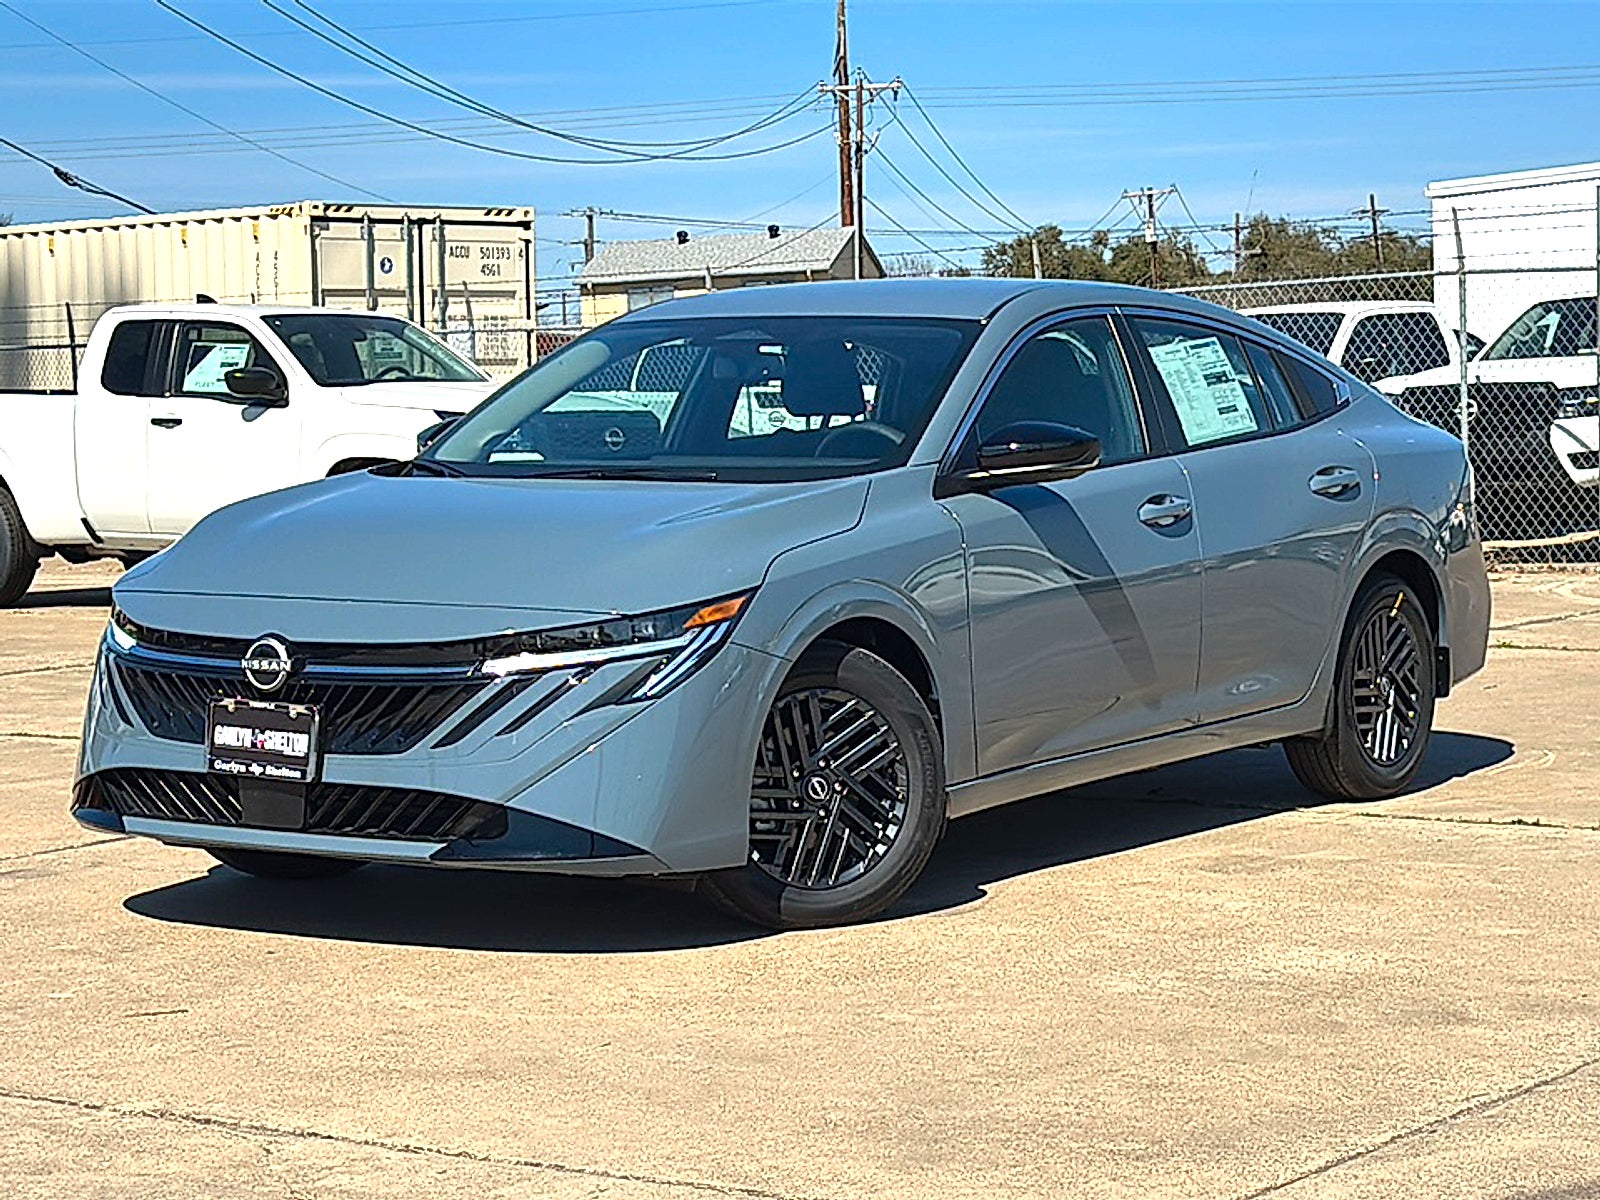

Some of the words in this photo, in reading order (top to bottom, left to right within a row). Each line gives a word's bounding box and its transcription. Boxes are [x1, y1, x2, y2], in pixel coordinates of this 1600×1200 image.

[479, 246, 511, 260] 501393
[480, 263, 501, 277] 45G1
[241, 658, 292, 672] NISSAN
[264, 729, 310, 754] SHELTON
